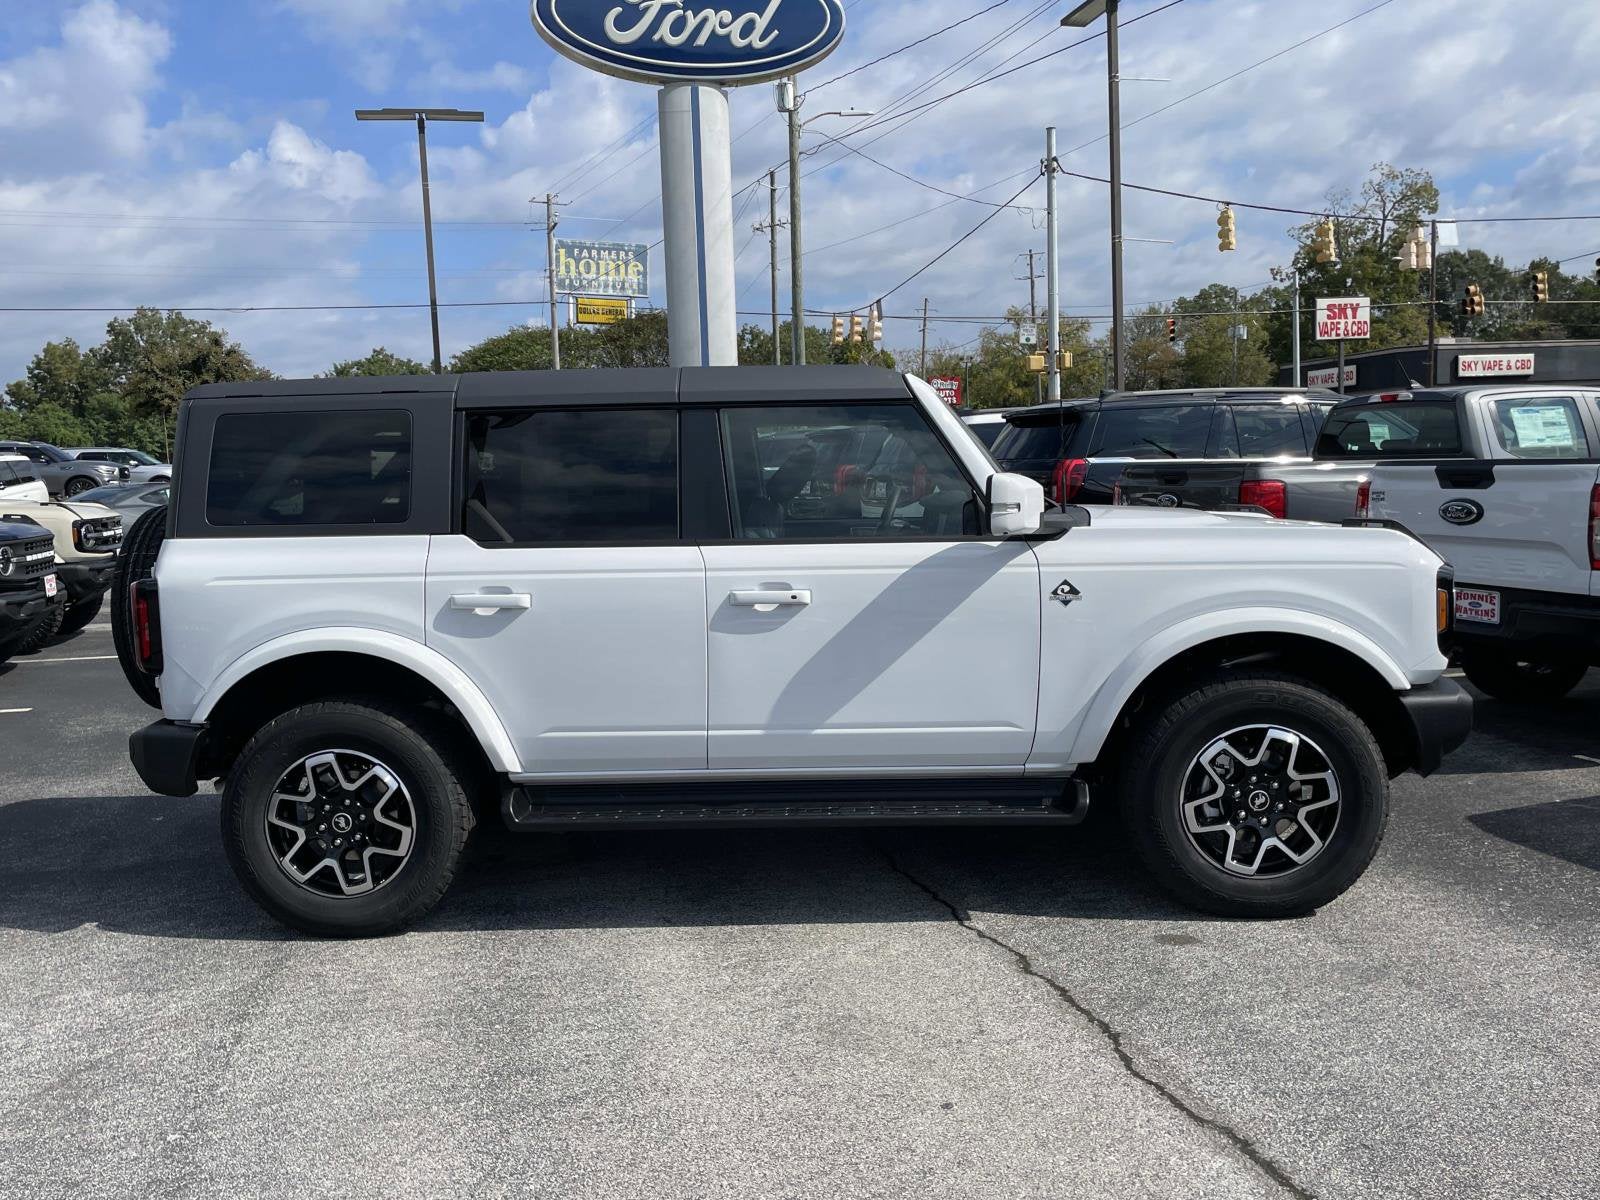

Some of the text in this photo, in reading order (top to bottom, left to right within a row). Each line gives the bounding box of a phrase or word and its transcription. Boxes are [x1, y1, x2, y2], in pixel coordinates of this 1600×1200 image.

[604, 0, 783, 49] Ford
[574, 248, 634, 260] FARMERS
[558, 248, 644, 280] home
[1326, 303, 1361, 321] SKY
[1318, 320, 1369, 337] VAPE & CBD
[1461, 359, 1532, 372] SKY VAPE & CBD
[1308, 374, 1320, 386] SKY
[1320, 372, 1336, 385] VAPE
[1456, 591, 1497, 606] RONNIE
[1455, 603, 1496, 618] WATKINS
